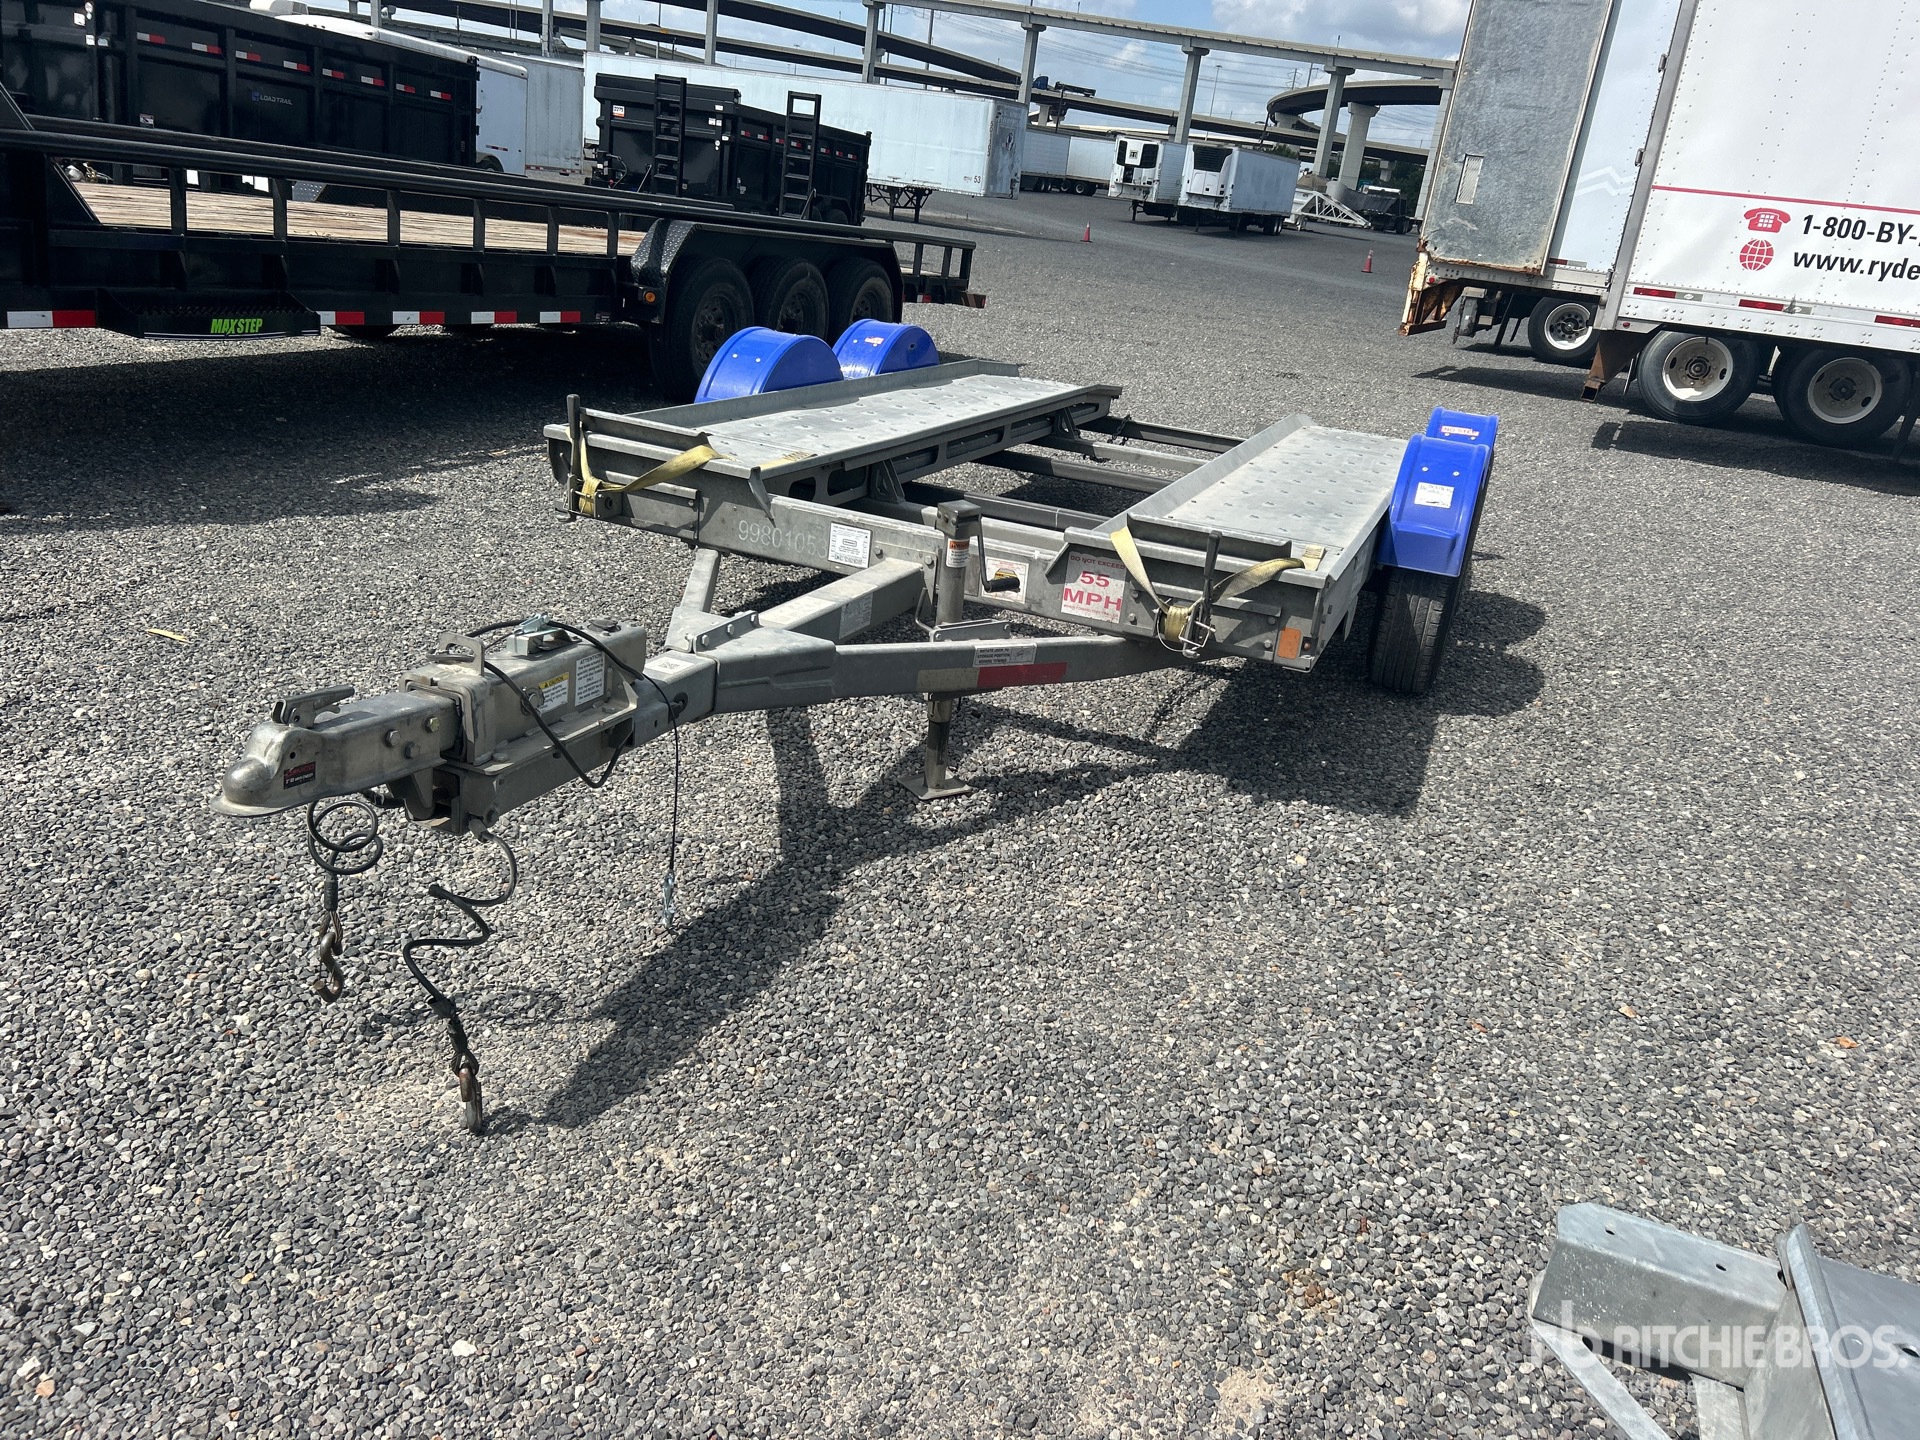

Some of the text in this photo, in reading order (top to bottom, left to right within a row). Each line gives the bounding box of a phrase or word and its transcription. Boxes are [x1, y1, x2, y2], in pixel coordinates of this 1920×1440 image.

[973, 175, 982, 184] 53
[1803, 214, 1920, 248] 1-800-BY-
[1793, 252, 1920, 282] www.ryde
[1082, 557, 1096, 565] NOT
[1097, 561, 1126, 570] EXCEED
[1080, 570, 1110, 588] 55
[1063, 587, 1123, 612] MPH
